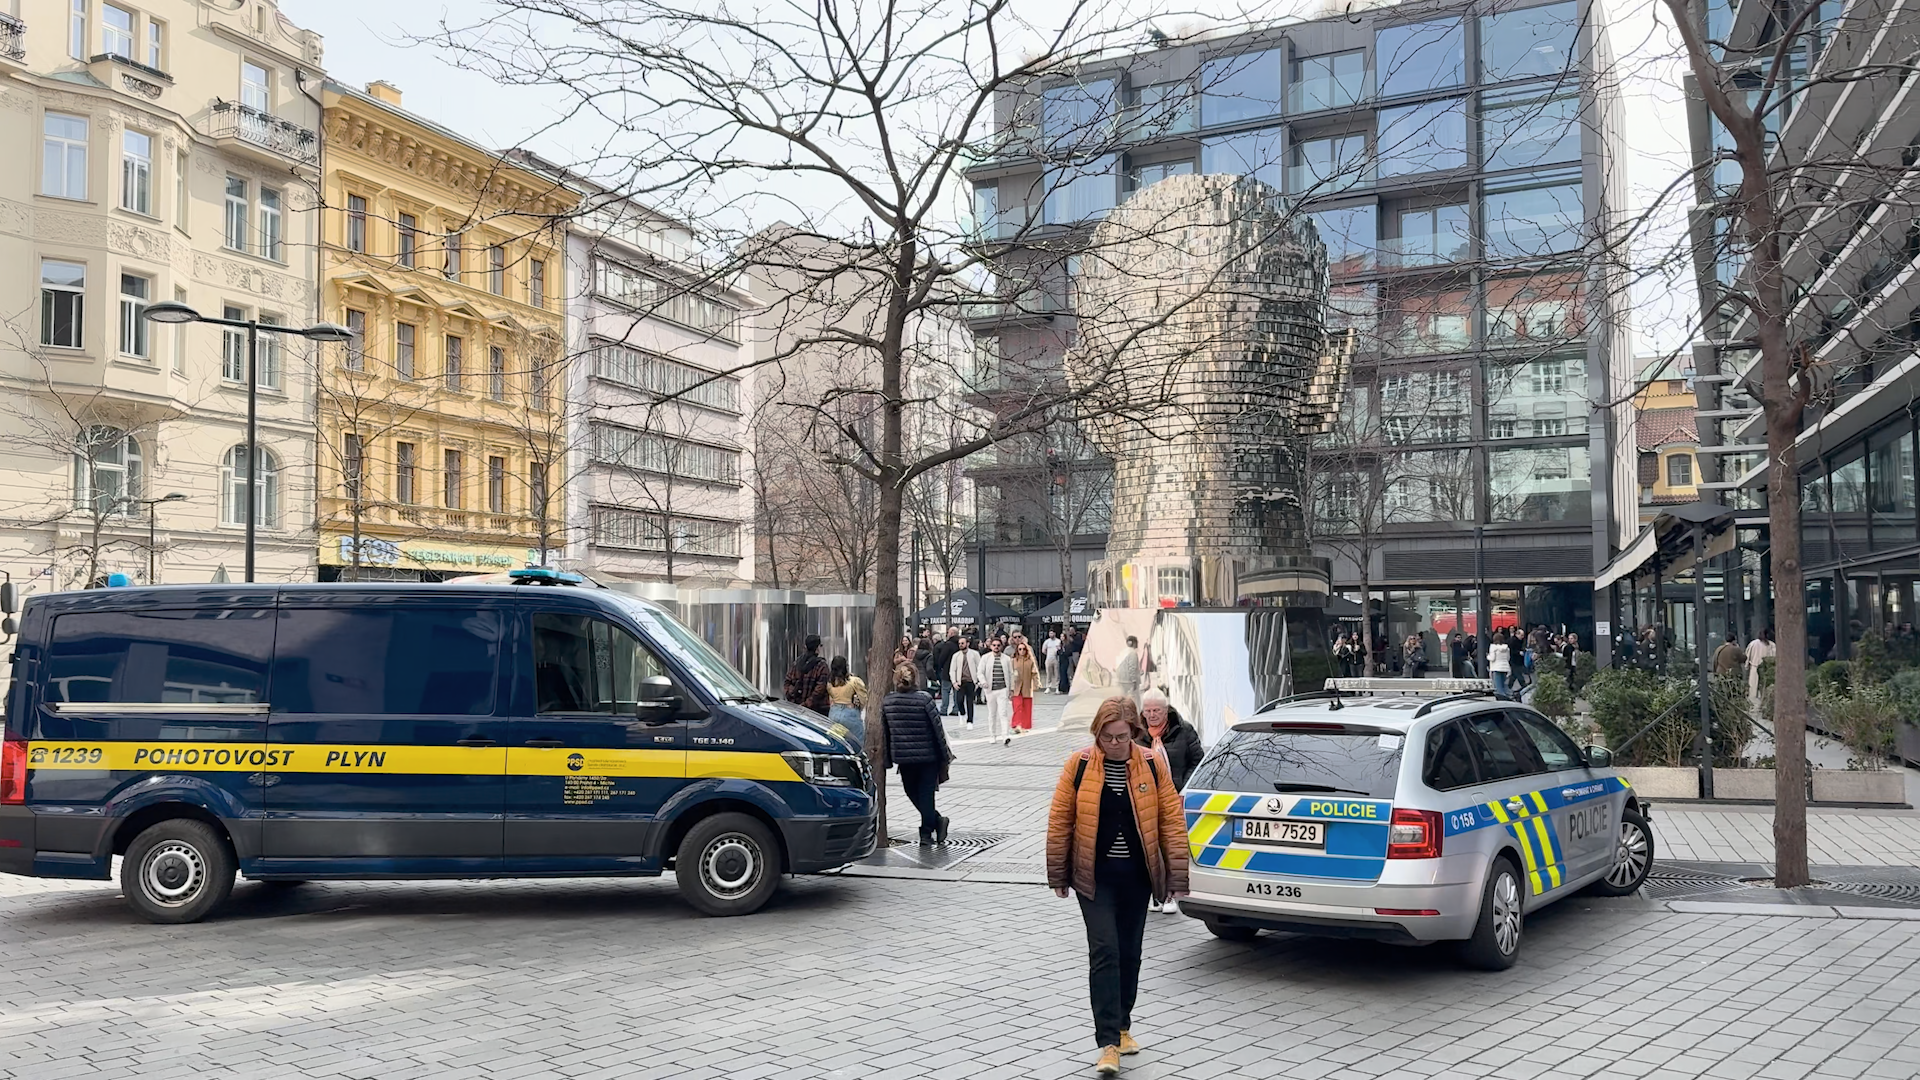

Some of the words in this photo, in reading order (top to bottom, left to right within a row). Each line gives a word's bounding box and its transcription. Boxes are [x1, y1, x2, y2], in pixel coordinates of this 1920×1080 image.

[52, 747, 103, 764] 1239
[134, 748, 295, 766] POHOTOVOST
[325, 751, 387, 767] PLYN
[1310, 802, 1377, 818] POLICIE
[1459, 811, 1475, 828] 158
[1569, 804, 1608, 842] POLICIE
[1245, 821, 1270, 838] 8AA
[1281, 823, 1317, 841] 7529
[1246, 882, 1272, 895] A13
[1276, 885, 1302, 898] 236
